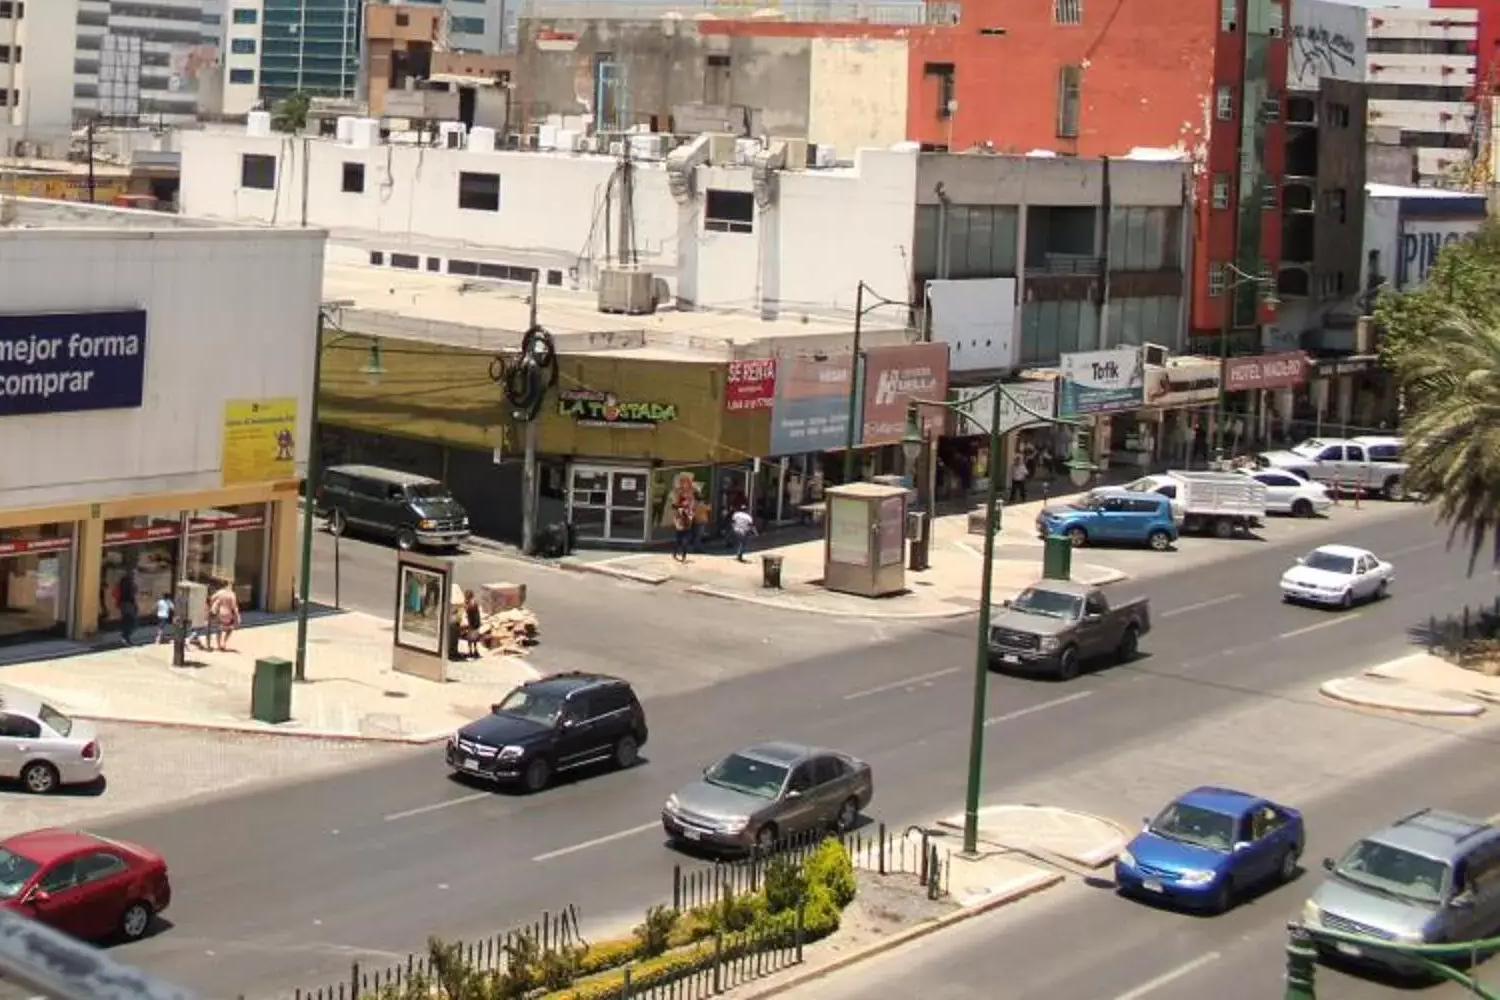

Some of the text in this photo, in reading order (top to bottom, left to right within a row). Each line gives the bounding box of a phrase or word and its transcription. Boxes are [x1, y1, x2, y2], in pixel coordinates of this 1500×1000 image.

[68, 333, 139, 358] forma
[727, 360, 775, 382] SE RENTA
[1231, 364, 1261, 381] HOTEL
[560, 398, 678, 421] LA TOSTADA
